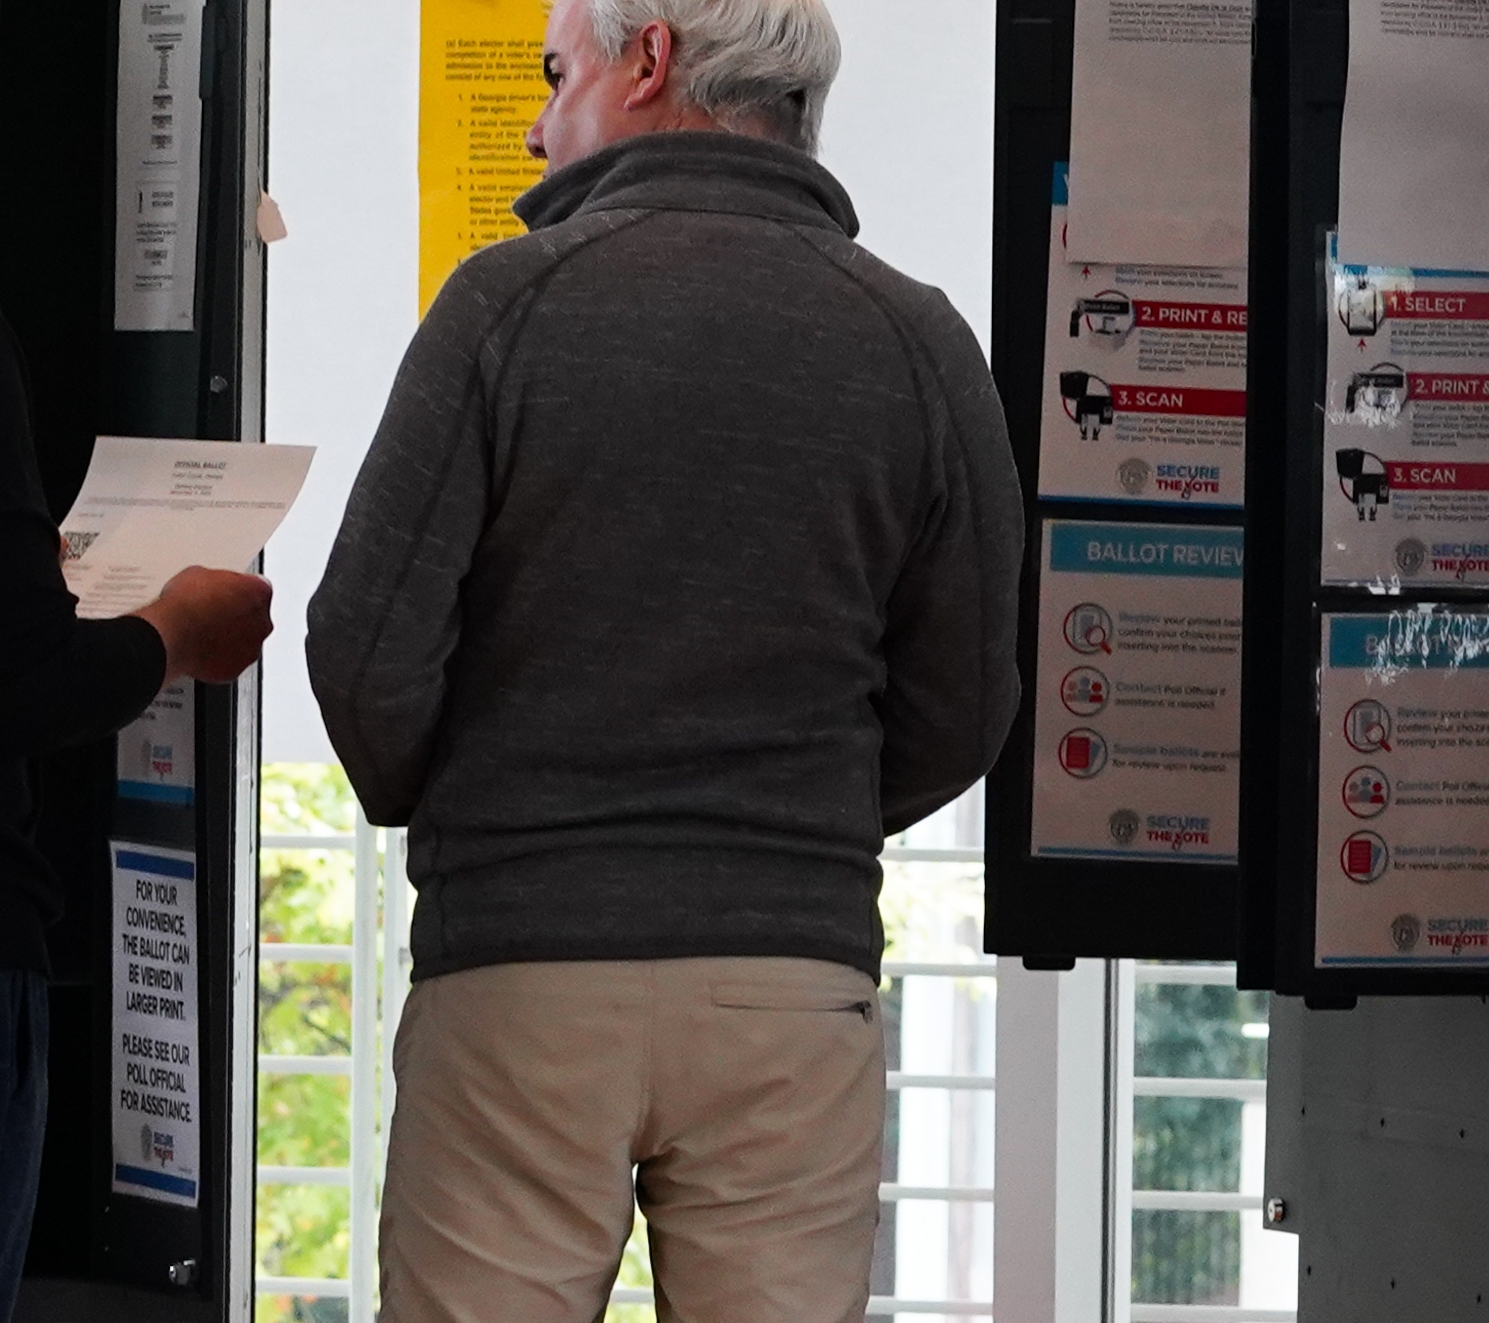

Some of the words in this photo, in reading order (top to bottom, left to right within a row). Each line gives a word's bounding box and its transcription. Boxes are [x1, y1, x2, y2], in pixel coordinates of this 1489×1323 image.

[1140, 307, 1156, 321] 2.
[1158, 307, 1208, 324] PRINT
[1211, 309, 1224, 325] &
[1226, 311, 1248, 326] RE
[1390, 296, 1402, 312] 1.
[1405, 296, 1466, 313] SELECT
[1118, 390, 1132, 406] 3.
[1135, 392, 1183, 407] SCAN
[1415, 378, 1428, 394] 2.
[1431, 379, 1480, 395] PRINT
[1156, 465, 1220, 479] SECURE
[1394, 466, 1407, 482] 3.
[1410, 467, 1456, 483] SCAN
[1156, 479, 1182, 491] THE
[1086, 540, 1168, 564] BALLOT
[1431, 558, 1459, 571] THE
[136, 878, 153, 901] FOR
[155, 884, 177, 907] YOUR
[126, 906, 187, 938] CONVENIENCE,
[122, 933, 138, 957] THE
[140, 936, 171, 962] BALLOT
[172, 943, 190, 965] CAN
[128, 962, 139, 985] BE
[141, 965, 173, 991] VIEWED
[173, 970, 183, 993] IN
[126, 990, 158, 1016] LARGER
[160, 997, 186, 1022] PRINT.
[122, 1032, 153, 1060] PLEASE
[154, 1040, 170, 1063] SEE
[171, 1043, 190, 1066] OUR
[127, 1062, 148, 1086] POLL
[149, 1066, 187, 1094] OFFICIAL
[121, 1088, 139, 1111] FOR
[140, 1092, 193, 1123] ASSISTANCE.
